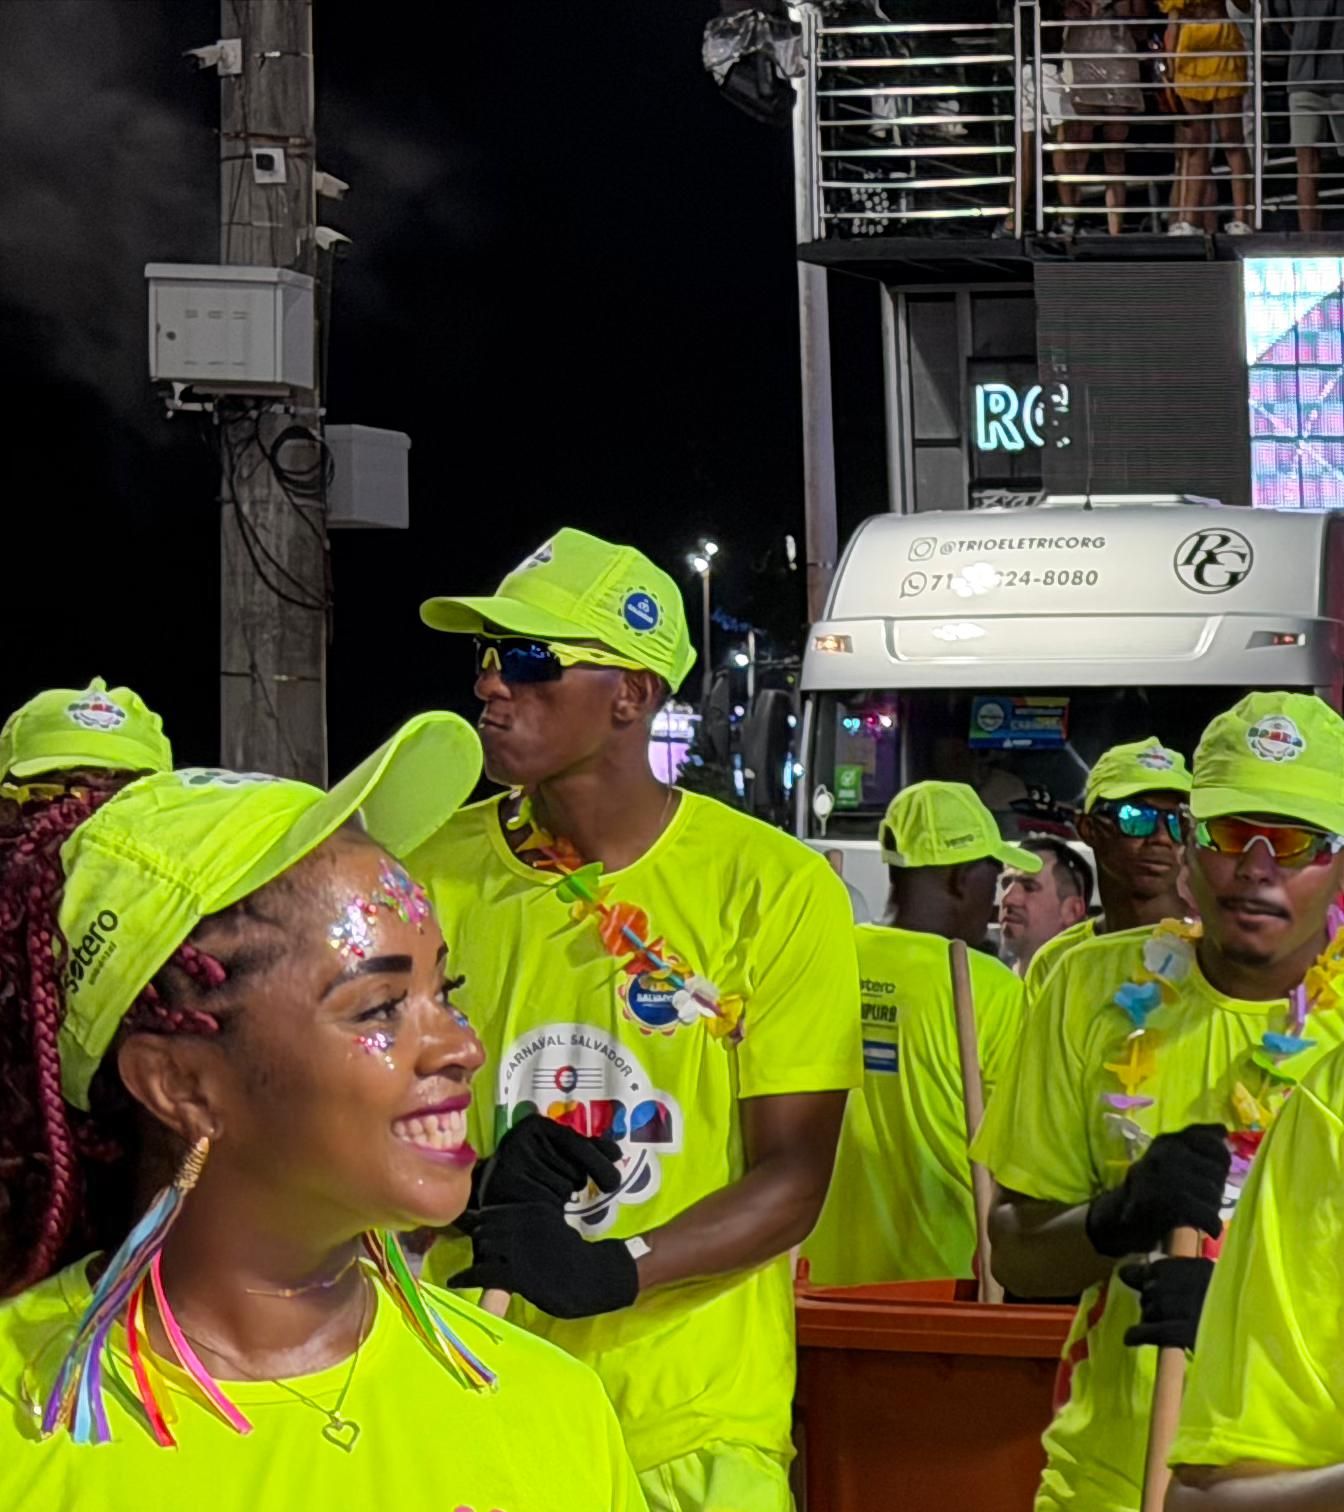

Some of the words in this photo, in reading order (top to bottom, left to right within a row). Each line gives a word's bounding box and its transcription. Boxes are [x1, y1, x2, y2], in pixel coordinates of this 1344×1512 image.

[939, 536, 1107, 556] @TRIOELETRICORG
[505, 1034, 565, 1080] CARNAVAL
[570, 1034, 633, 1078] SALVADOR
